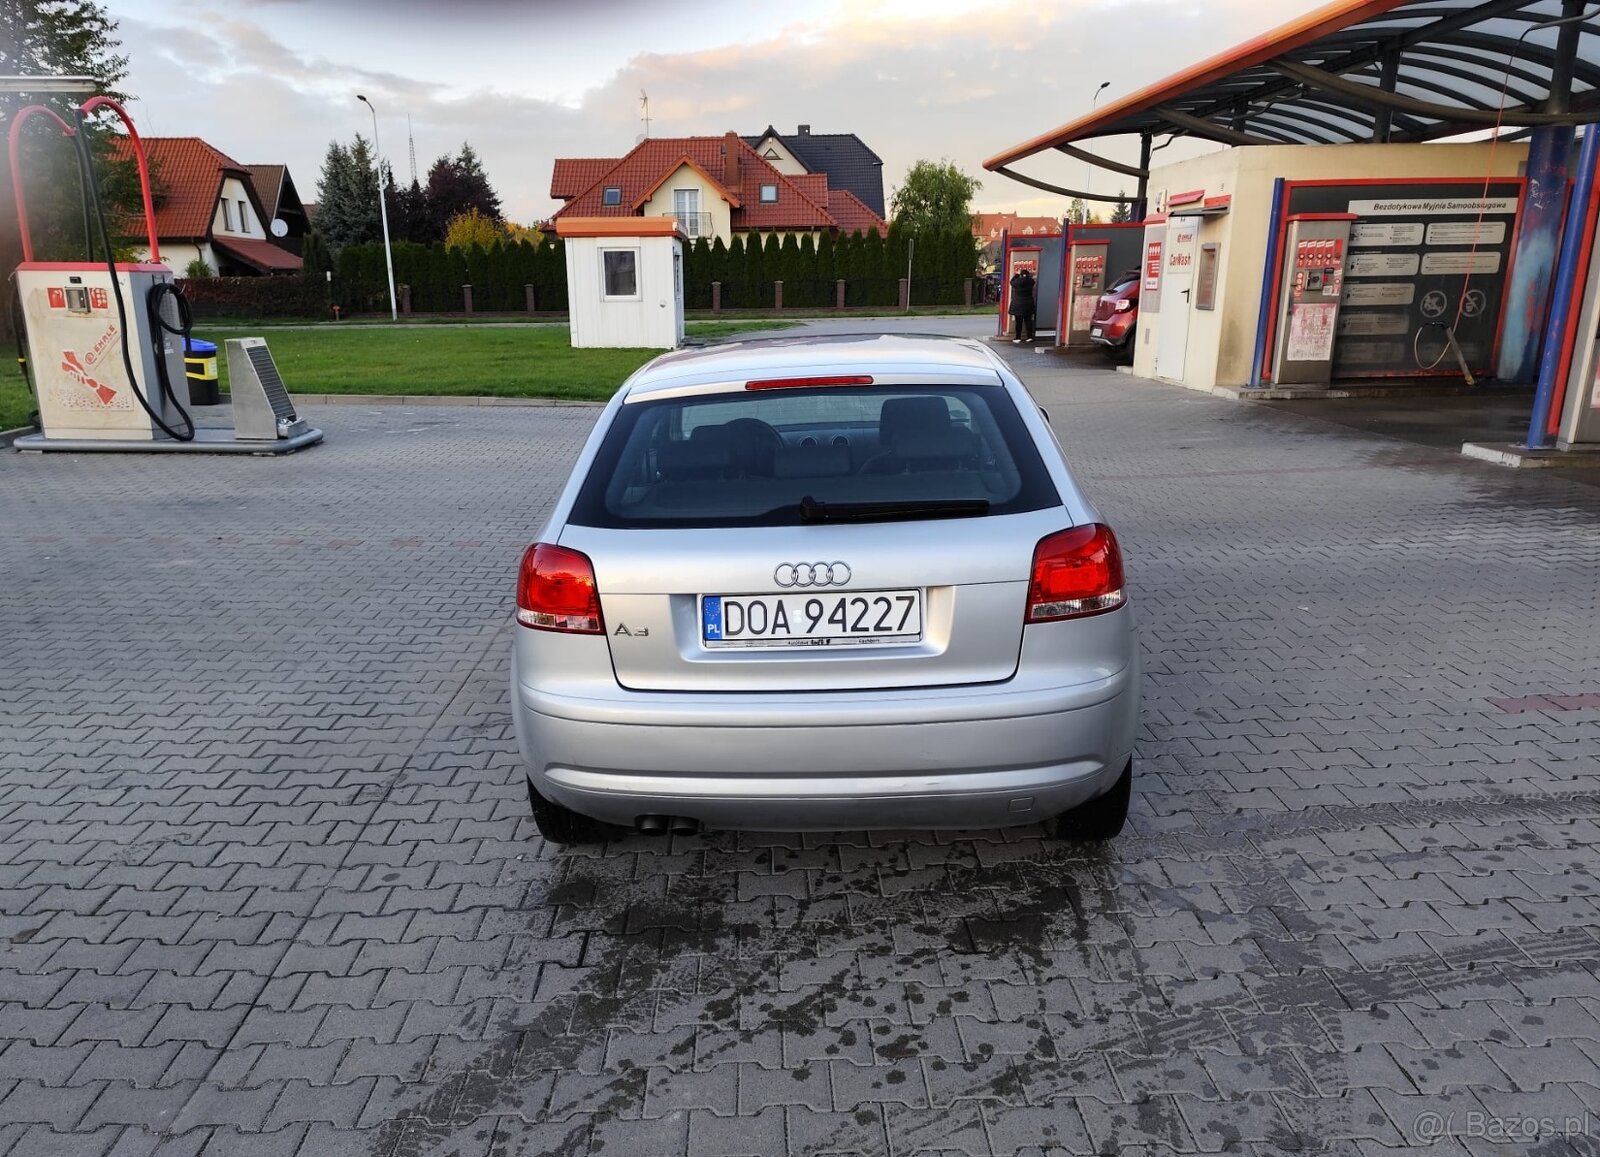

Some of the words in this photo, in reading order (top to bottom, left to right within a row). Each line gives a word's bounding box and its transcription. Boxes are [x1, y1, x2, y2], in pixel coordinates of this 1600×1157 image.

[1373, 202, 1422, 211] Bezdotykowa
[1423, 202, 1446, 211] Myjnia
[707, 624, 720, 634] PL
[724, 599, 791, 636] DOA
[805, 595, 915, 634] 94227
[613, 623, 649, 637] A3
